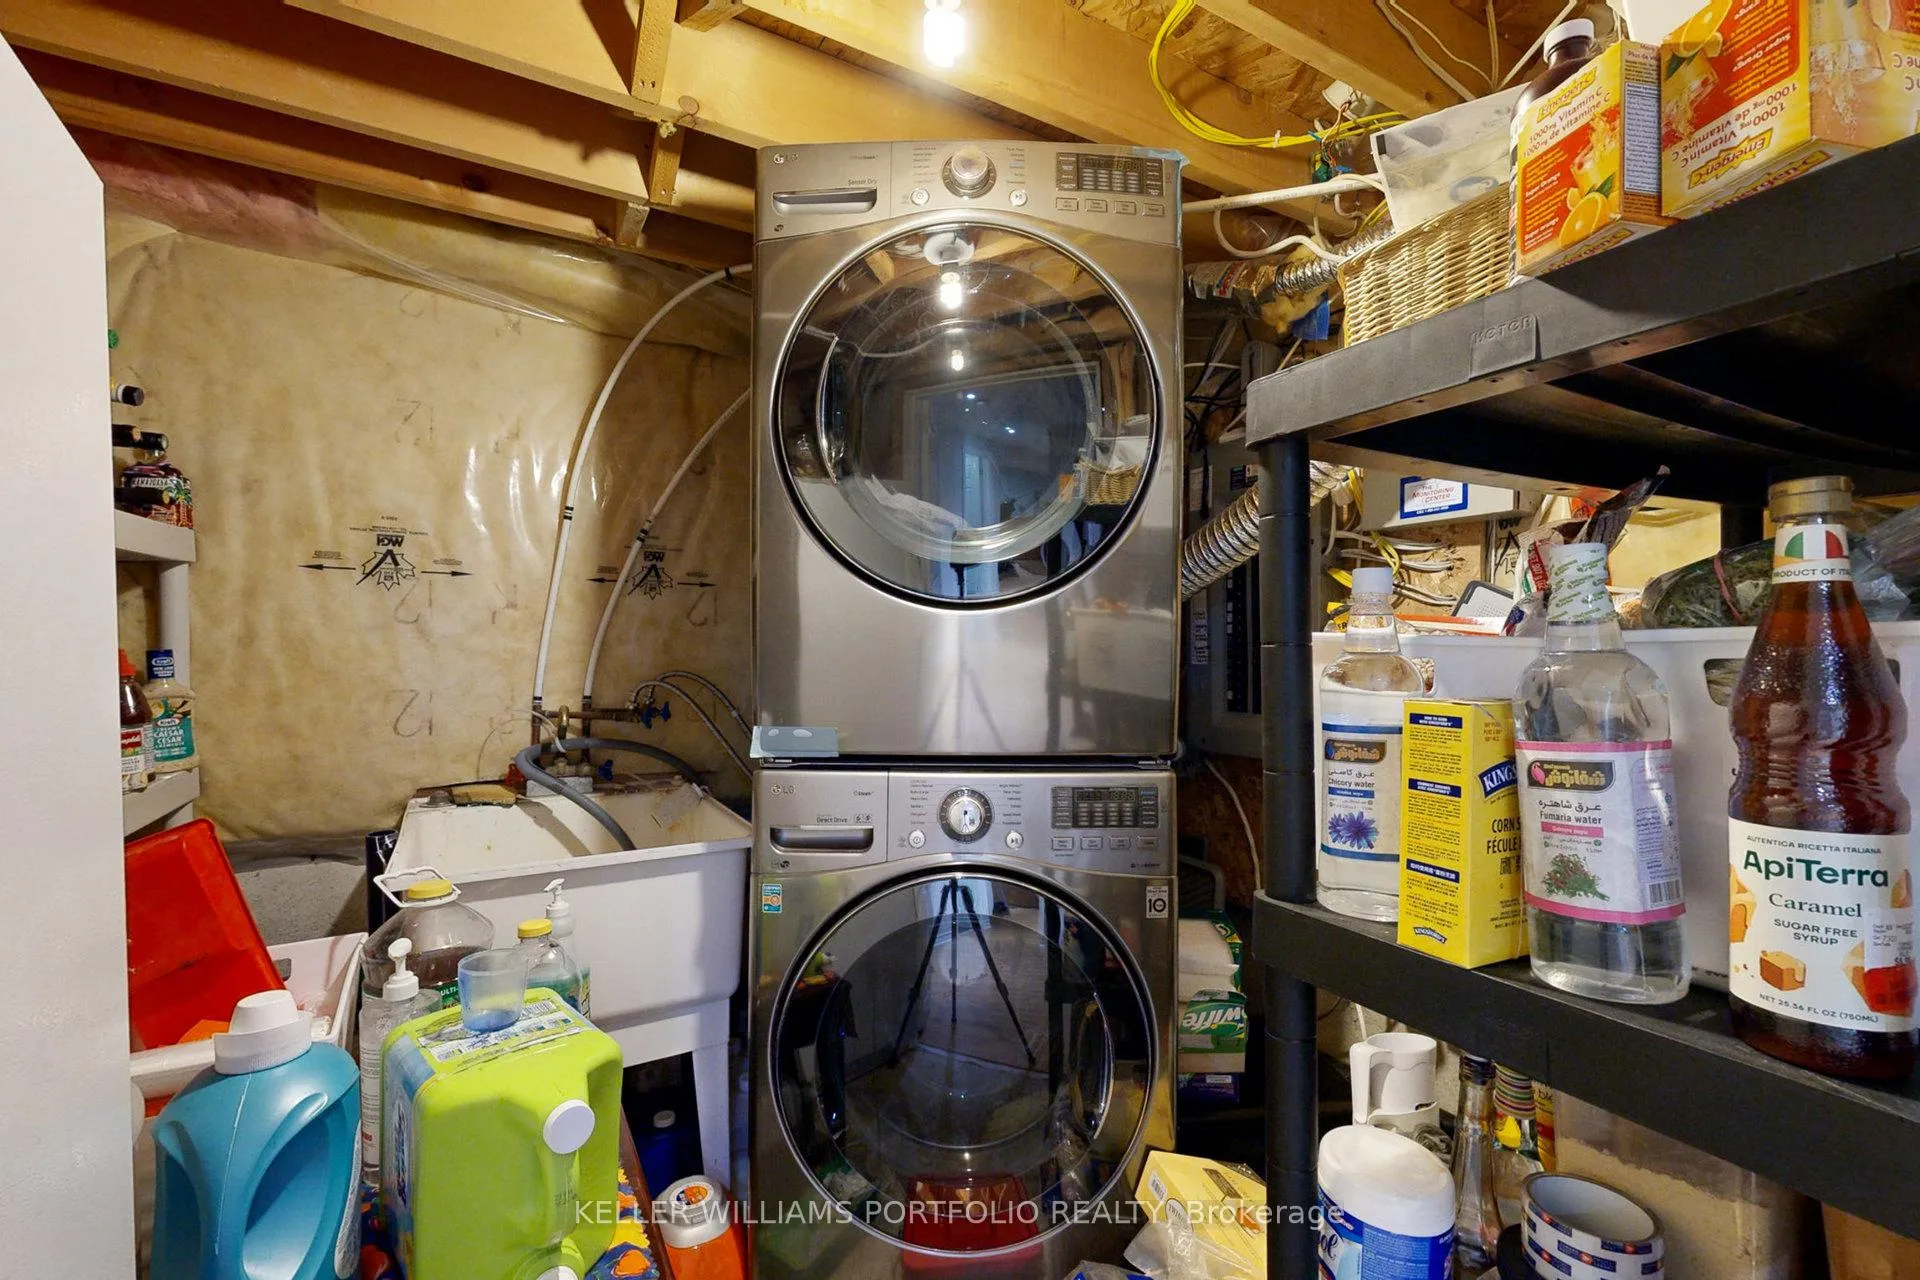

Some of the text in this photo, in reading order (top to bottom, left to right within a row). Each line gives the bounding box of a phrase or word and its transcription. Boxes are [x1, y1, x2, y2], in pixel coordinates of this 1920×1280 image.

[1682, 121, 1732, 152] vitamine
[1689, 130, 1737, 159] Vitamin
[867, 178, 878, 187] Dry
[1820, 567, 1836, 576] OF
[153, 729, 184, 738] CAESAR
[1354, 781, 1376, 789] water
[816, 816, 848, 824] Direct Drive
[1539, 811, 1602, 825] Fumaria water
[1491, 819, 1515, 833] CORN
[1486, 838, 1517, 854] FÉCULE
[1747, 834, 1795, 849] AUTENTICA
[1797, 843, 1841, 852] RICETTA
[1743, 850, 1889, 888] ApiTerra
[1768, 893, 1862, 918] Caramel
[1774, 918, 1858, 938] SUGAR FREE
[1793, 932, 1839, 946] SYRUP
[1760, 993, 1775, 1003] NET
[1807, 1006, 1819, 1015] FL
[1821, 1010, 1837, 1018] OZ
